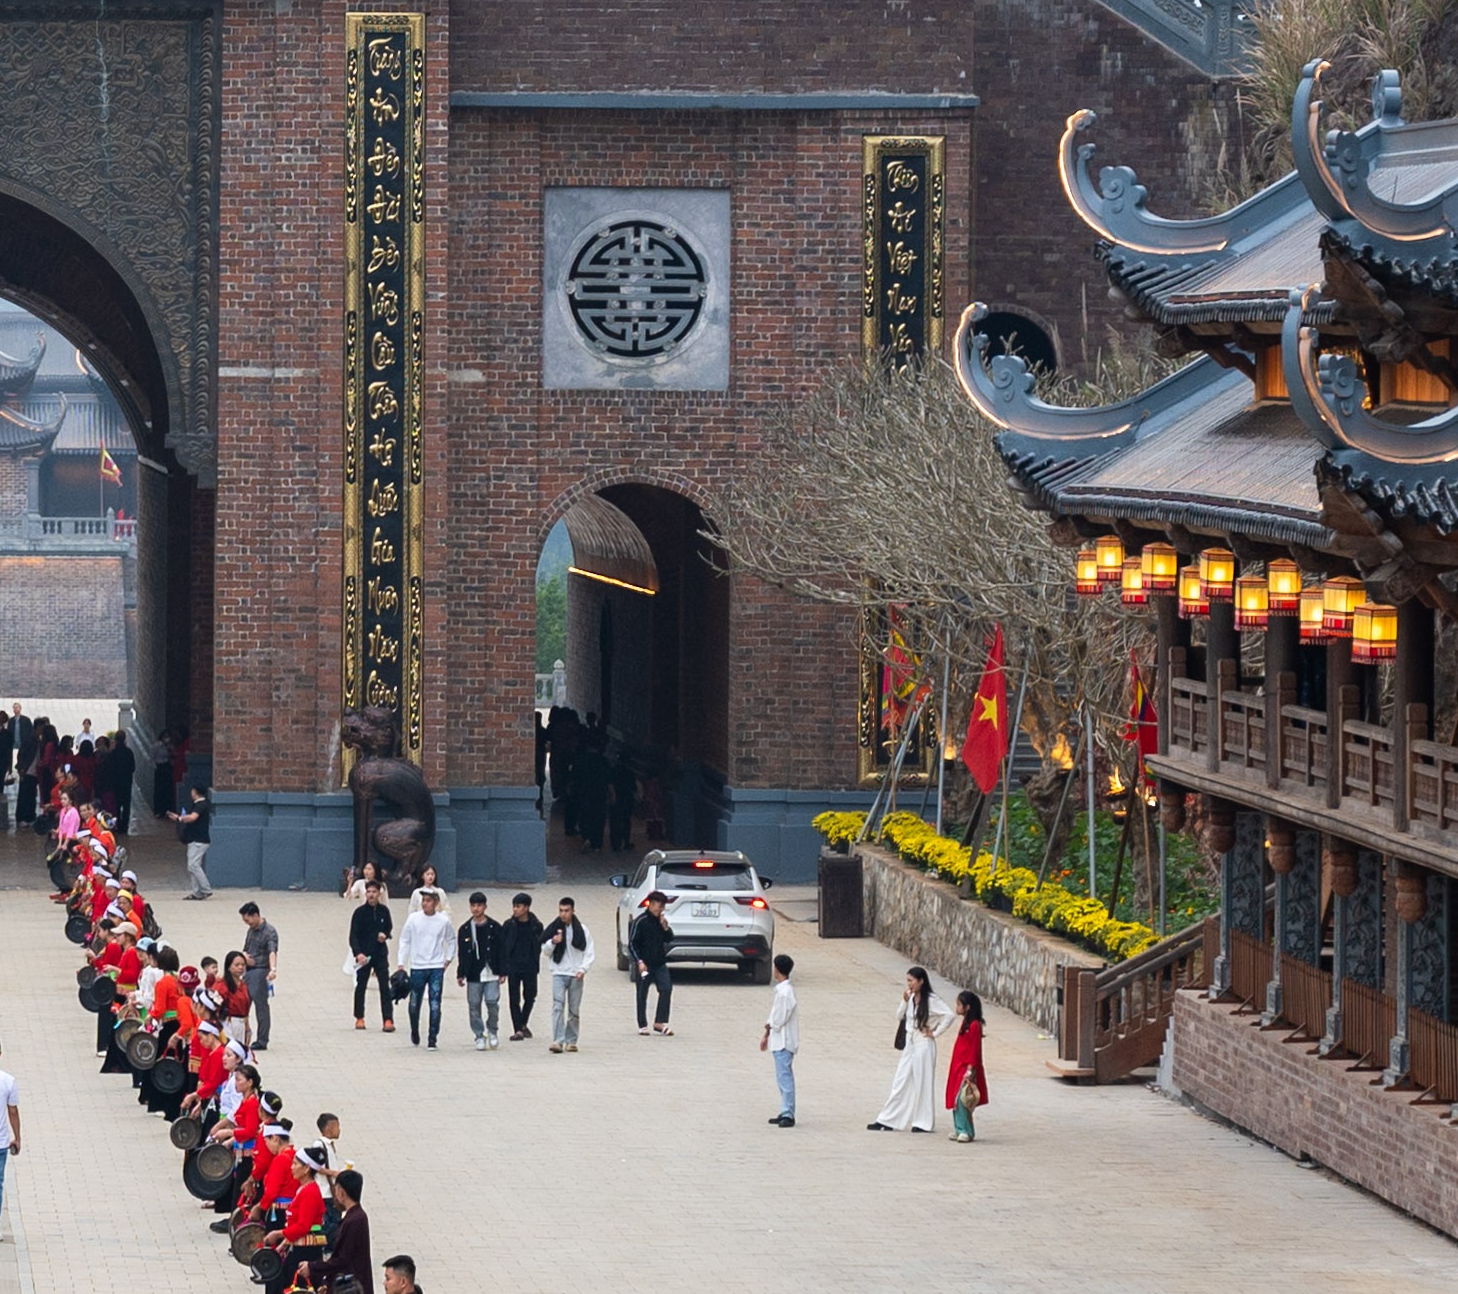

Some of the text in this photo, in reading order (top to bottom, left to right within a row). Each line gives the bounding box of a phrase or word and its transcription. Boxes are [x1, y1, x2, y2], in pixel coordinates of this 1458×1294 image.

[368, 37, 401, 80] Tràng
[367, 137, 400, 179] Đền
[367, 185, 401, 224] Đài
[367, 235, 400, 273] Bền
[887, 241, 917, 274] Việt
[887, 283, 916, 315] Nam
[372, 331, 395, 370] Cầu
[368, 478, 398, 517] Quốc
[372, 527, 395, 565] Gia
[368, 576, 398, 615] Muôn
[368, 624, 398, 663] Năm
